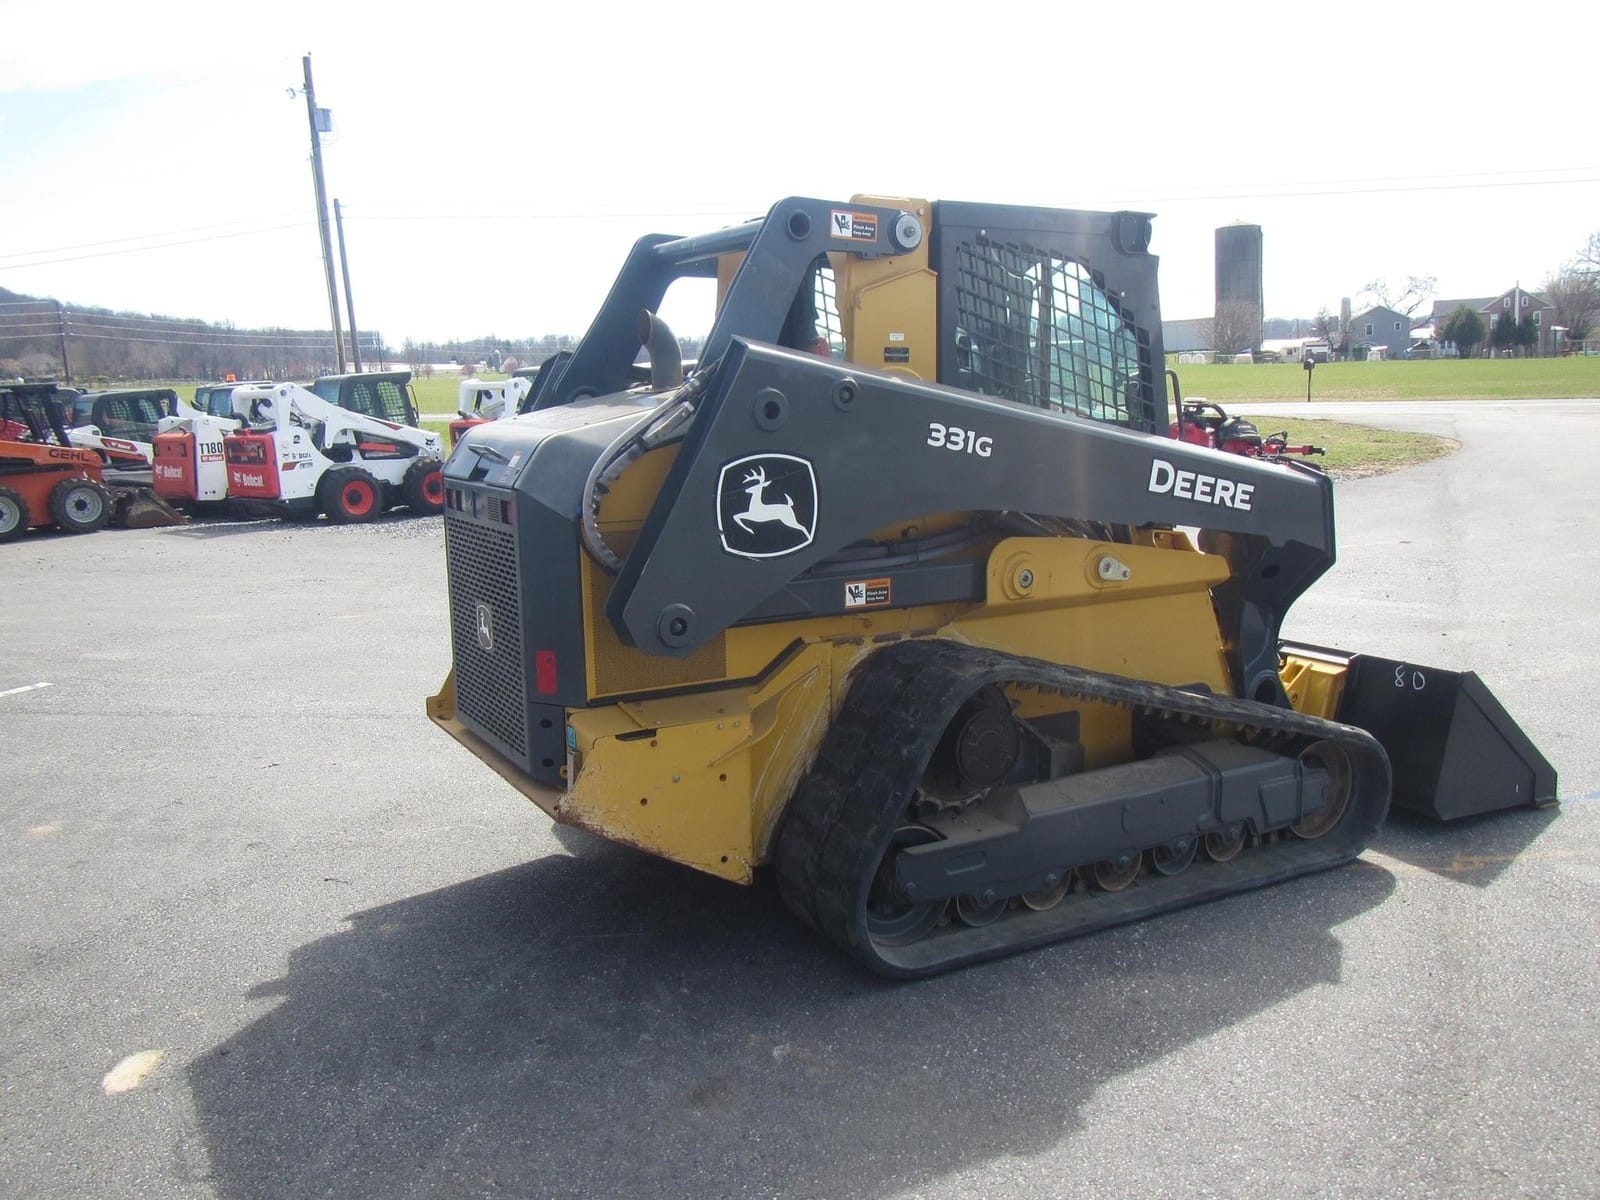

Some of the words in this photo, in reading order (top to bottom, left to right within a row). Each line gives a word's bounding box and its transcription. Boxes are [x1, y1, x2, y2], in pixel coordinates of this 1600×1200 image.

[926, 422, 994, 458] 331G
[48, 448, 91, 462] GEHL
[199, 441, 224, 455] T180
[163, 465, 183, 479] Bobcat
[242, 473, 264, 488] Bobcat
[1148, 458, 1256, 511] DEERE
[1394, 664, 1426, 690] 80
